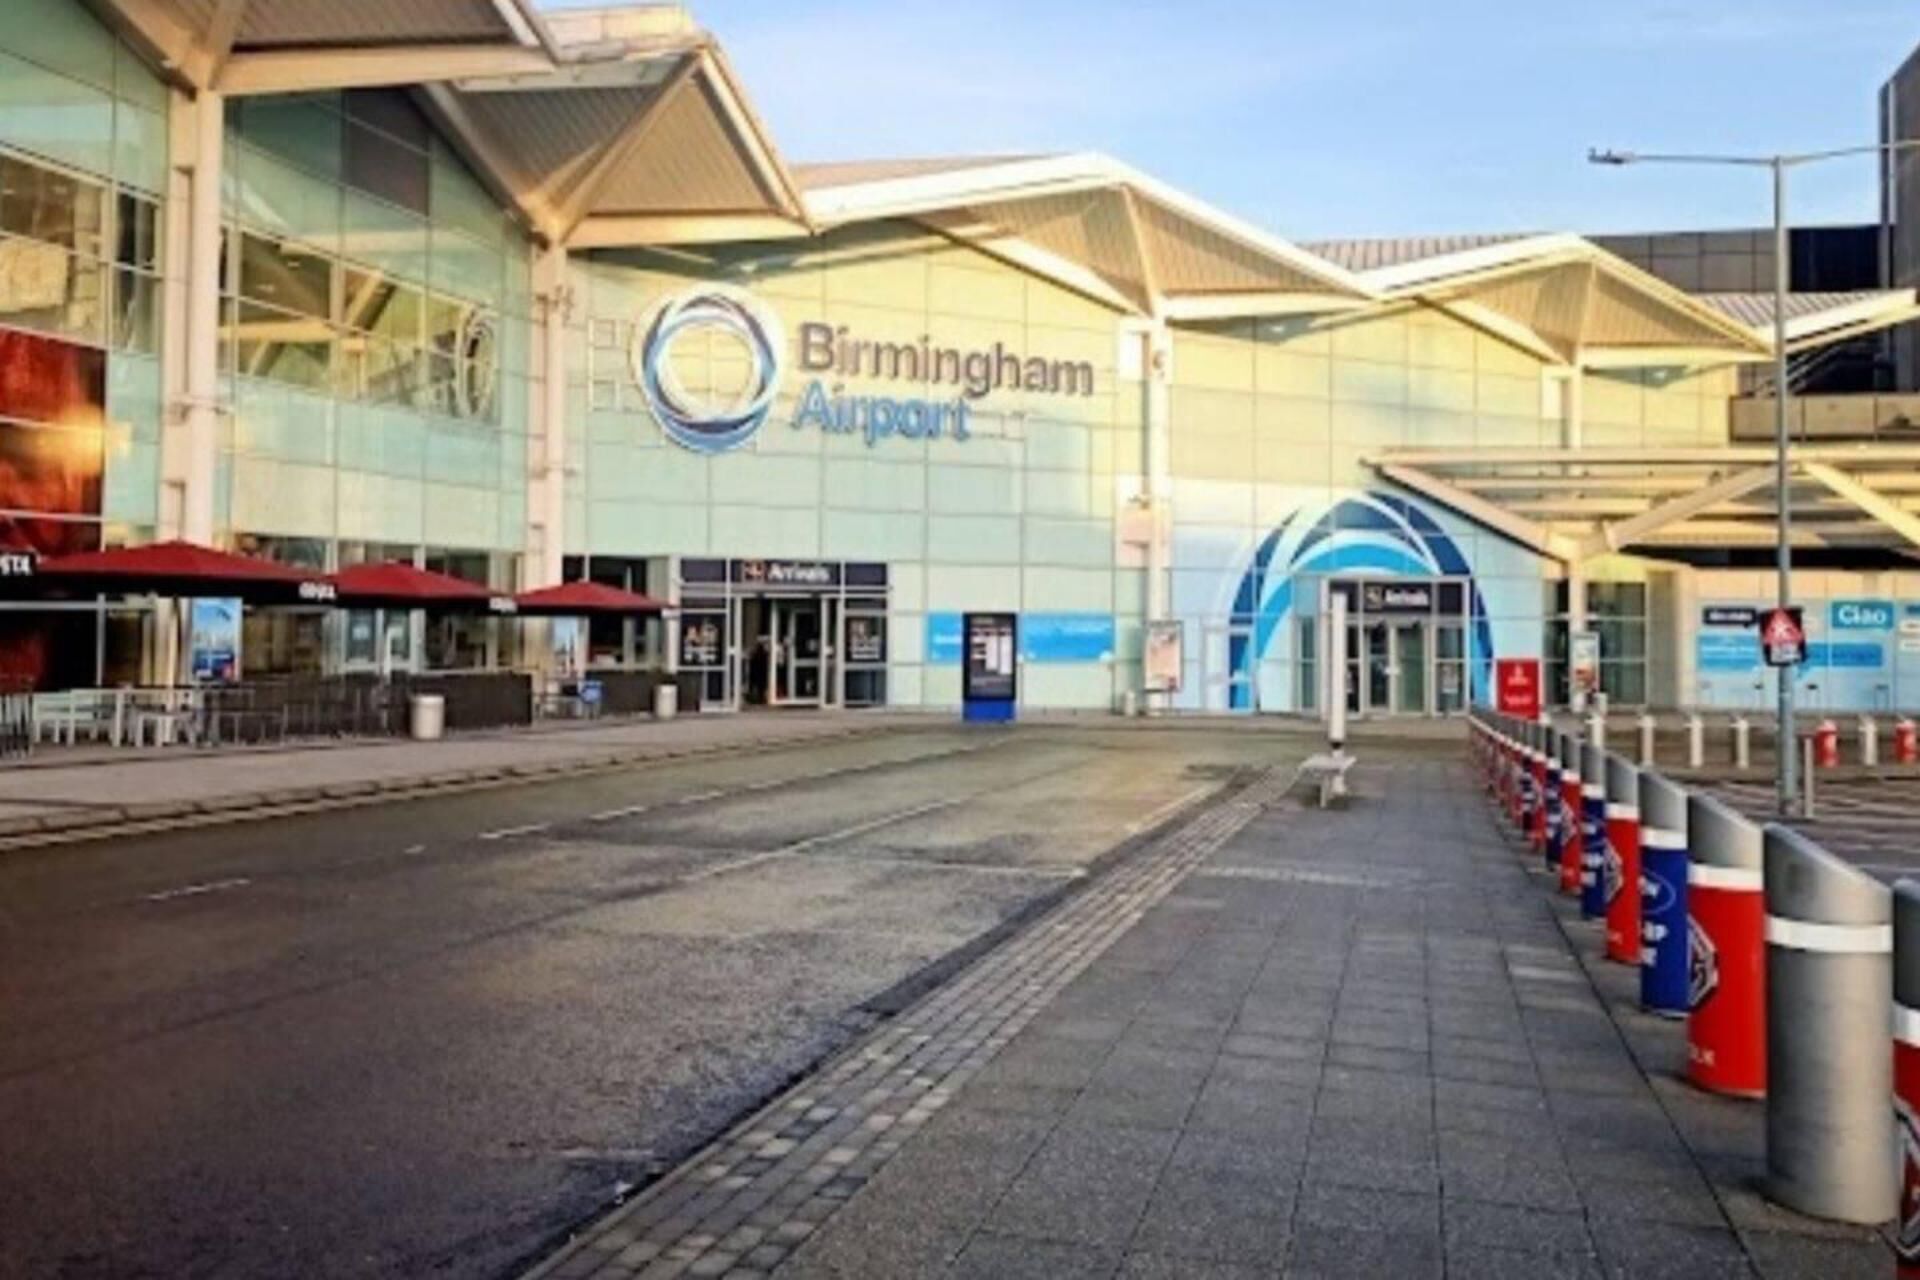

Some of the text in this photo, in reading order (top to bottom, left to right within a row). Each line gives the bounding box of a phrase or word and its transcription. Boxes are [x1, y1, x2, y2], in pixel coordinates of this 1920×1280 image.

[798, 321, 1094, 398] Birmingham
[791, 378, 971, 447] Airport
[1838, 604, 1887, 625] Ciao
